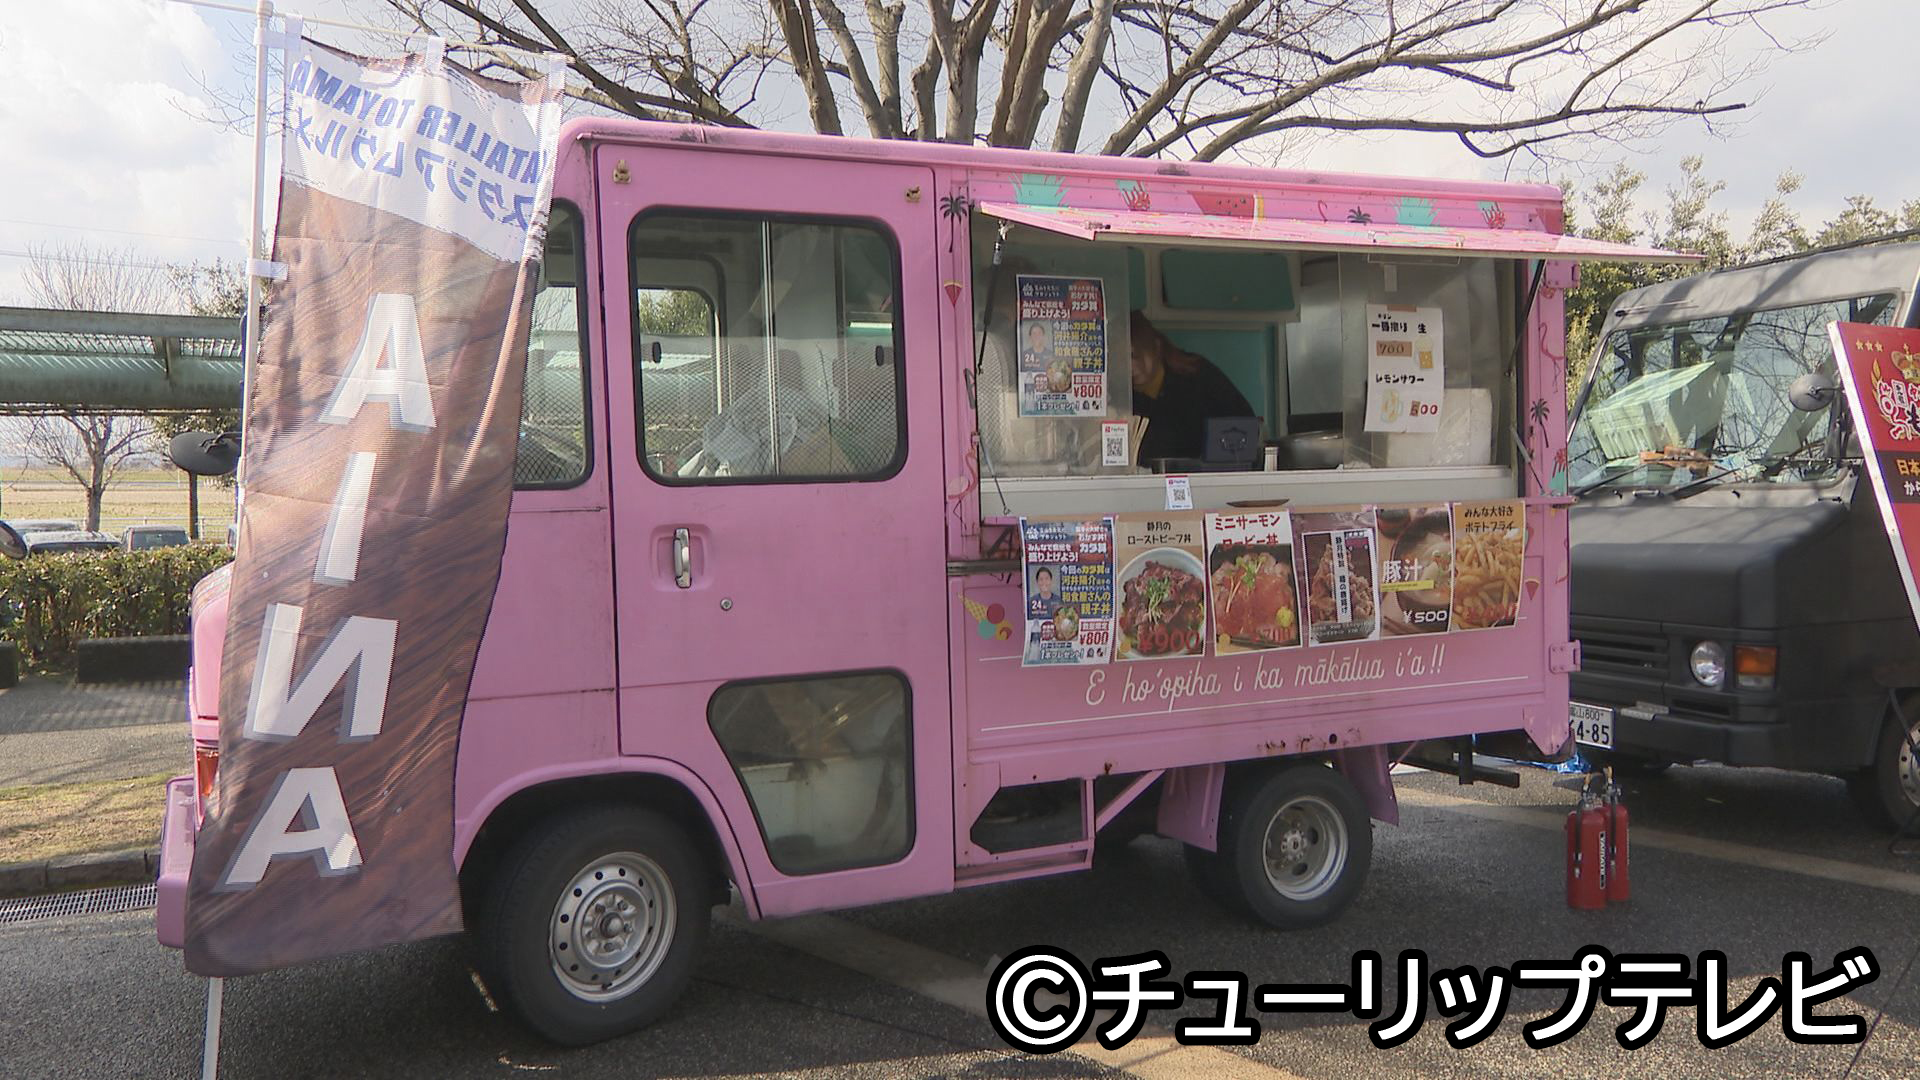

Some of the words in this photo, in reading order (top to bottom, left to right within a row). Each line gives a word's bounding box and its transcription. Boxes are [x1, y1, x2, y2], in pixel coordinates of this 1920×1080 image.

[1418, 323, 1427, 334] 生
[1379, 343, 1405, 355] 700
[1376, 374, 1424, 384] レモンサワー
[1074, 385, 1102, 398] ¥800
[1464, 506, 1514, 518] みんな大好き
[1215, 514, 1280, 531] ミニサーモン
[1465, 521, 1514, 533] ポテトフライ
[1127, 534, 1191, 545] ローストビーフ丼
[1382, 558, 1423, 584] 豚汁
[1031, 600, 1042, 609] 24
[1403, 610, 1448, 624] ¥500
[1079, 631, 1109, 645] ¥800
[1086, 669, 1105, 706] E
[1233, 666, 1243, 692] i
[1254, 655, 1283, 690] ka
